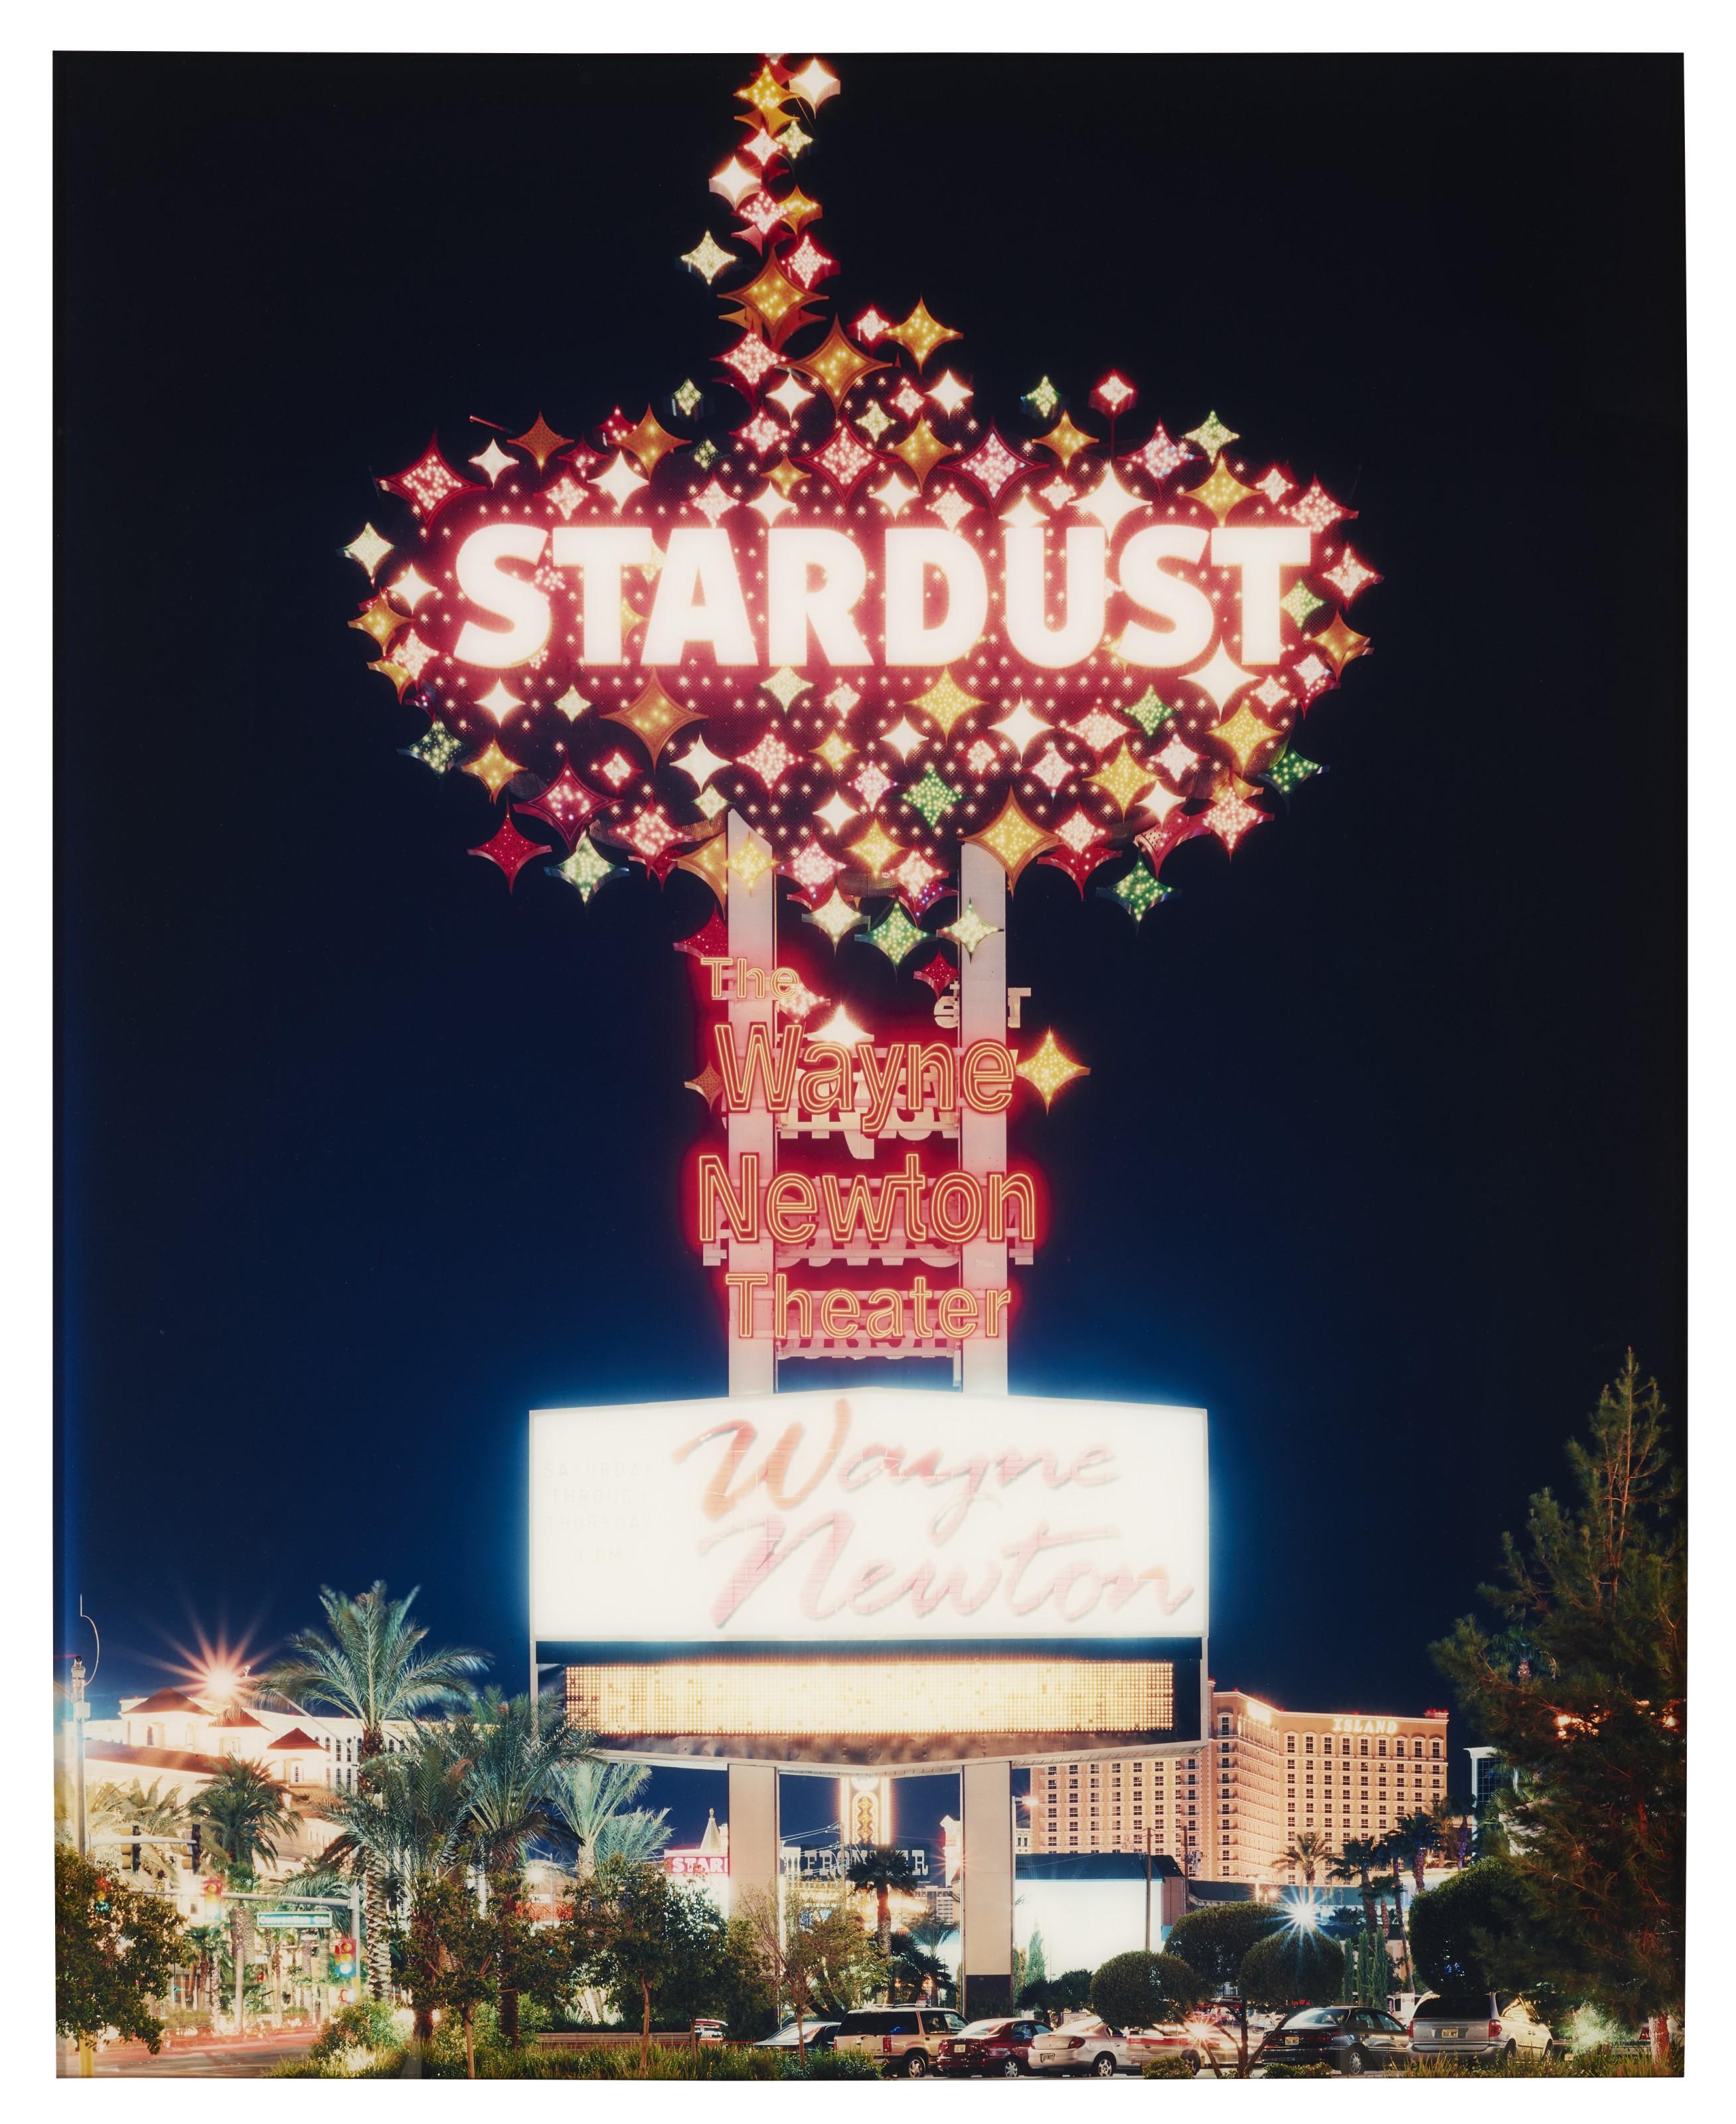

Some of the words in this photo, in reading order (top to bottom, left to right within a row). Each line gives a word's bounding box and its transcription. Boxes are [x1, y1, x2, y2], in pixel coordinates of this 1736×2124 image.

[453, 524, 1311, 668] STARDUST
[700, 957, 799, 999] The
[714, 1022, 1017, 1132] Wayne
[697, 1152, 1036, 1245] Newton
[725, 1272, 1012, 1339] Theater
[672, 1397, 1122, 1547] Wayne
[697, 1509, 1194, 1629] Newton
[1332, 1716, 1397, 1734] ISLAND
